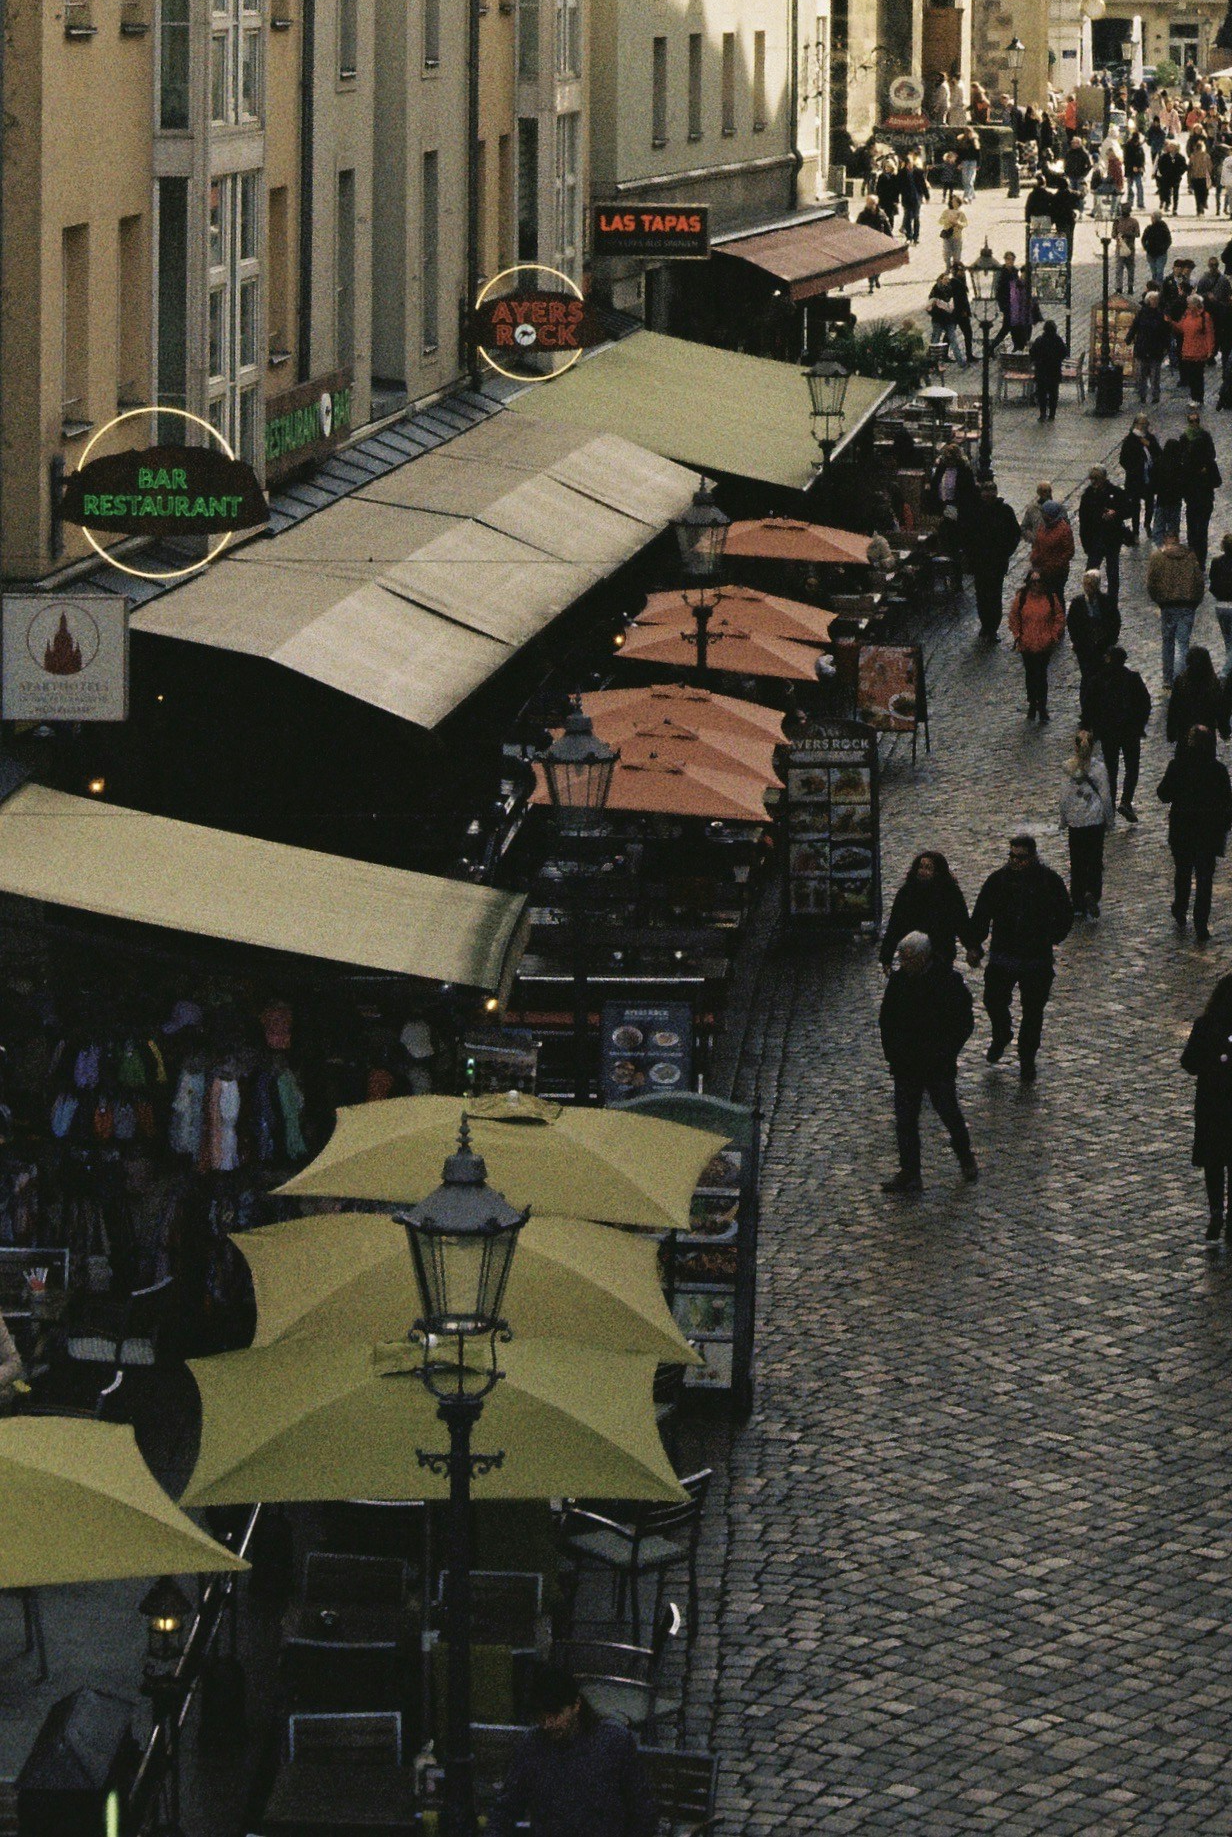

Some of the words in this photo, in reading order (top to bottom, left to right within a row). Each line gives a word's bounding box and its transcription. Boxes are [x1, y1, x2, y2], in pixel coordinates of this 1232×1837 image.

[600, 214, 636, 232] LAS
[641, 214, 701, 233] TAPAS
[491, 301, 584, 323] AYERS
[496, 324, 578, 346] ROCK
[138, 468, 188, 489] BAR
[83, 495, 243, 517] RESTAURANT
[832, 738, 870, 750] ROCK
